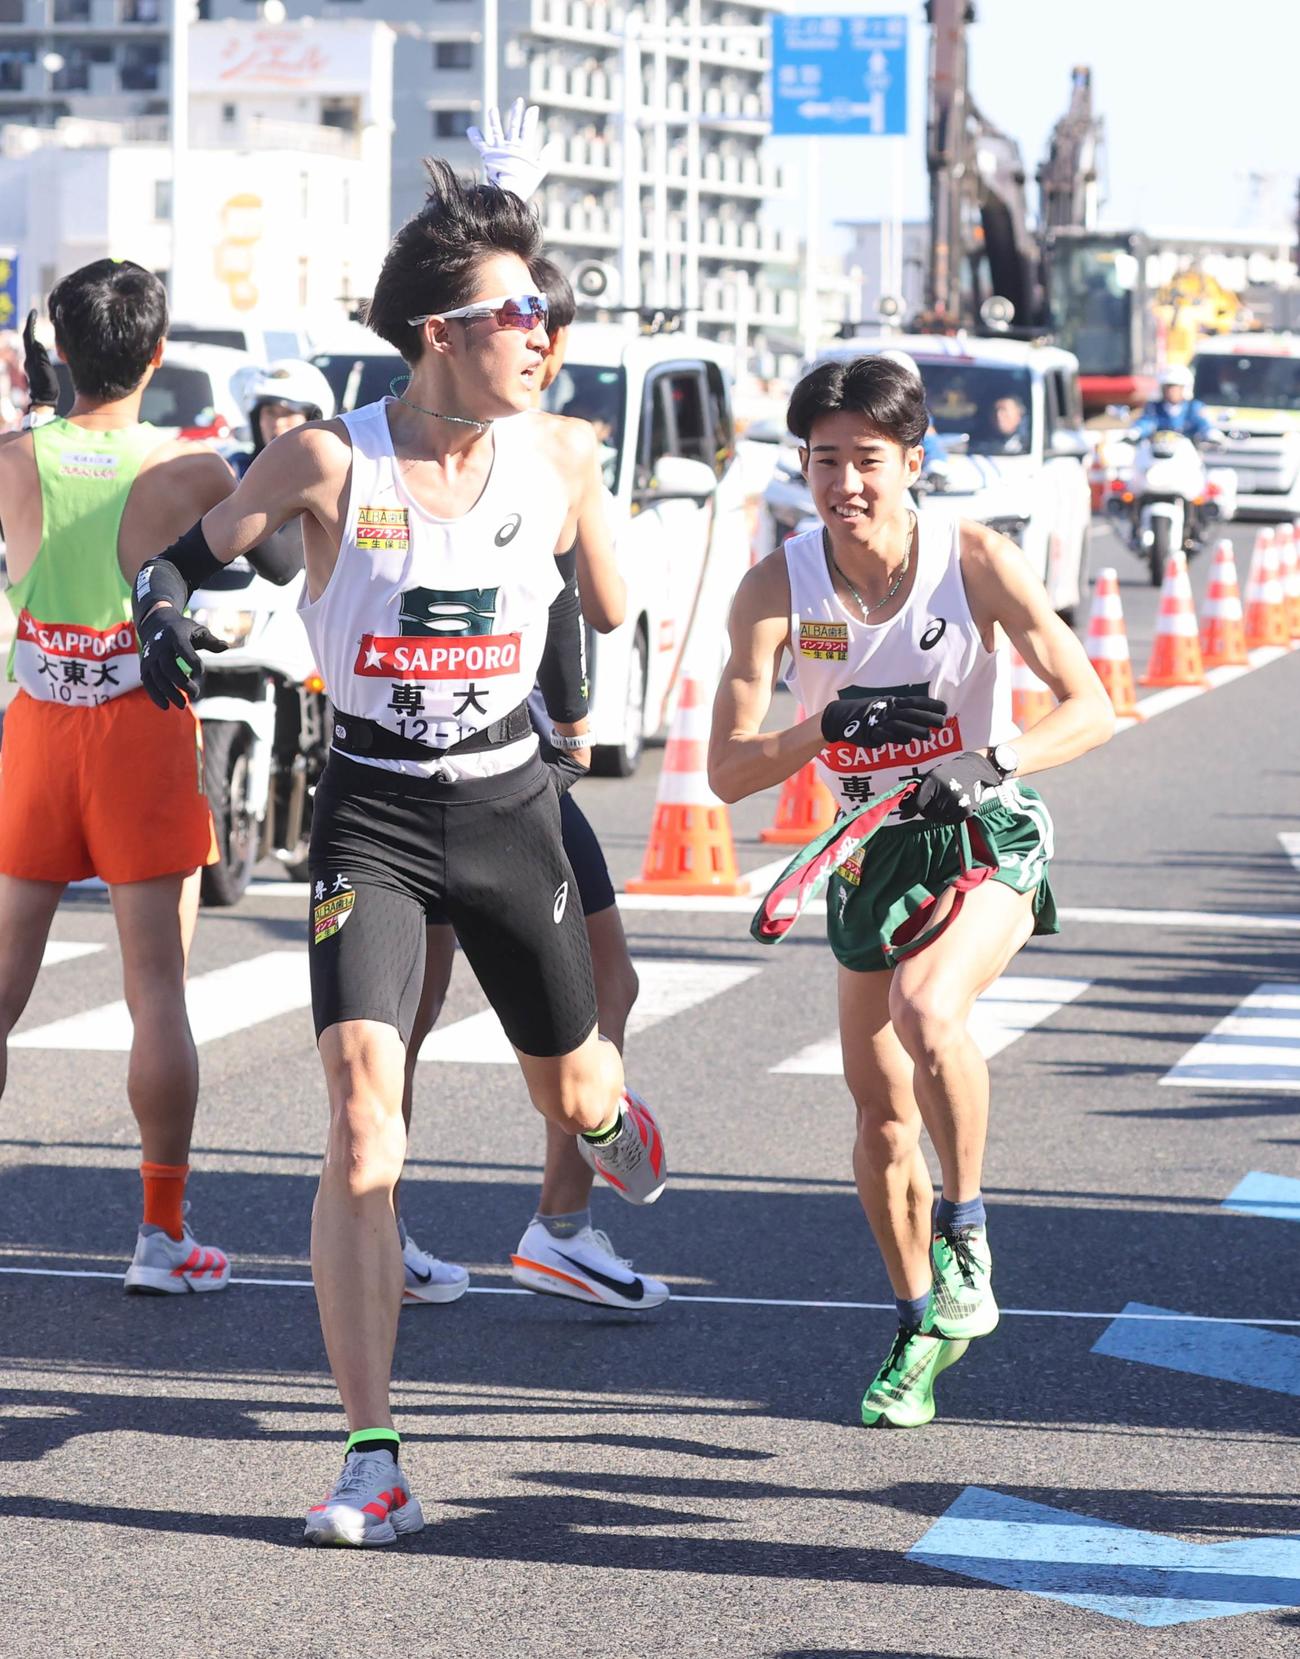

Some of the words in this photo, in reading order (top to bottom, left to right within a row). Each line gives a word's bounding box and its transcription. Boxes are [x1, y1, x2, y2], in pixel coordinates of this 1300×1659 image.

[37, 629, 132, 656] SAPPORO
[800, 625, 847, 637] ALBA歯科
[38, 654, 120, 687] 大東大
[393, 643, 517, 672] SAPPORO
